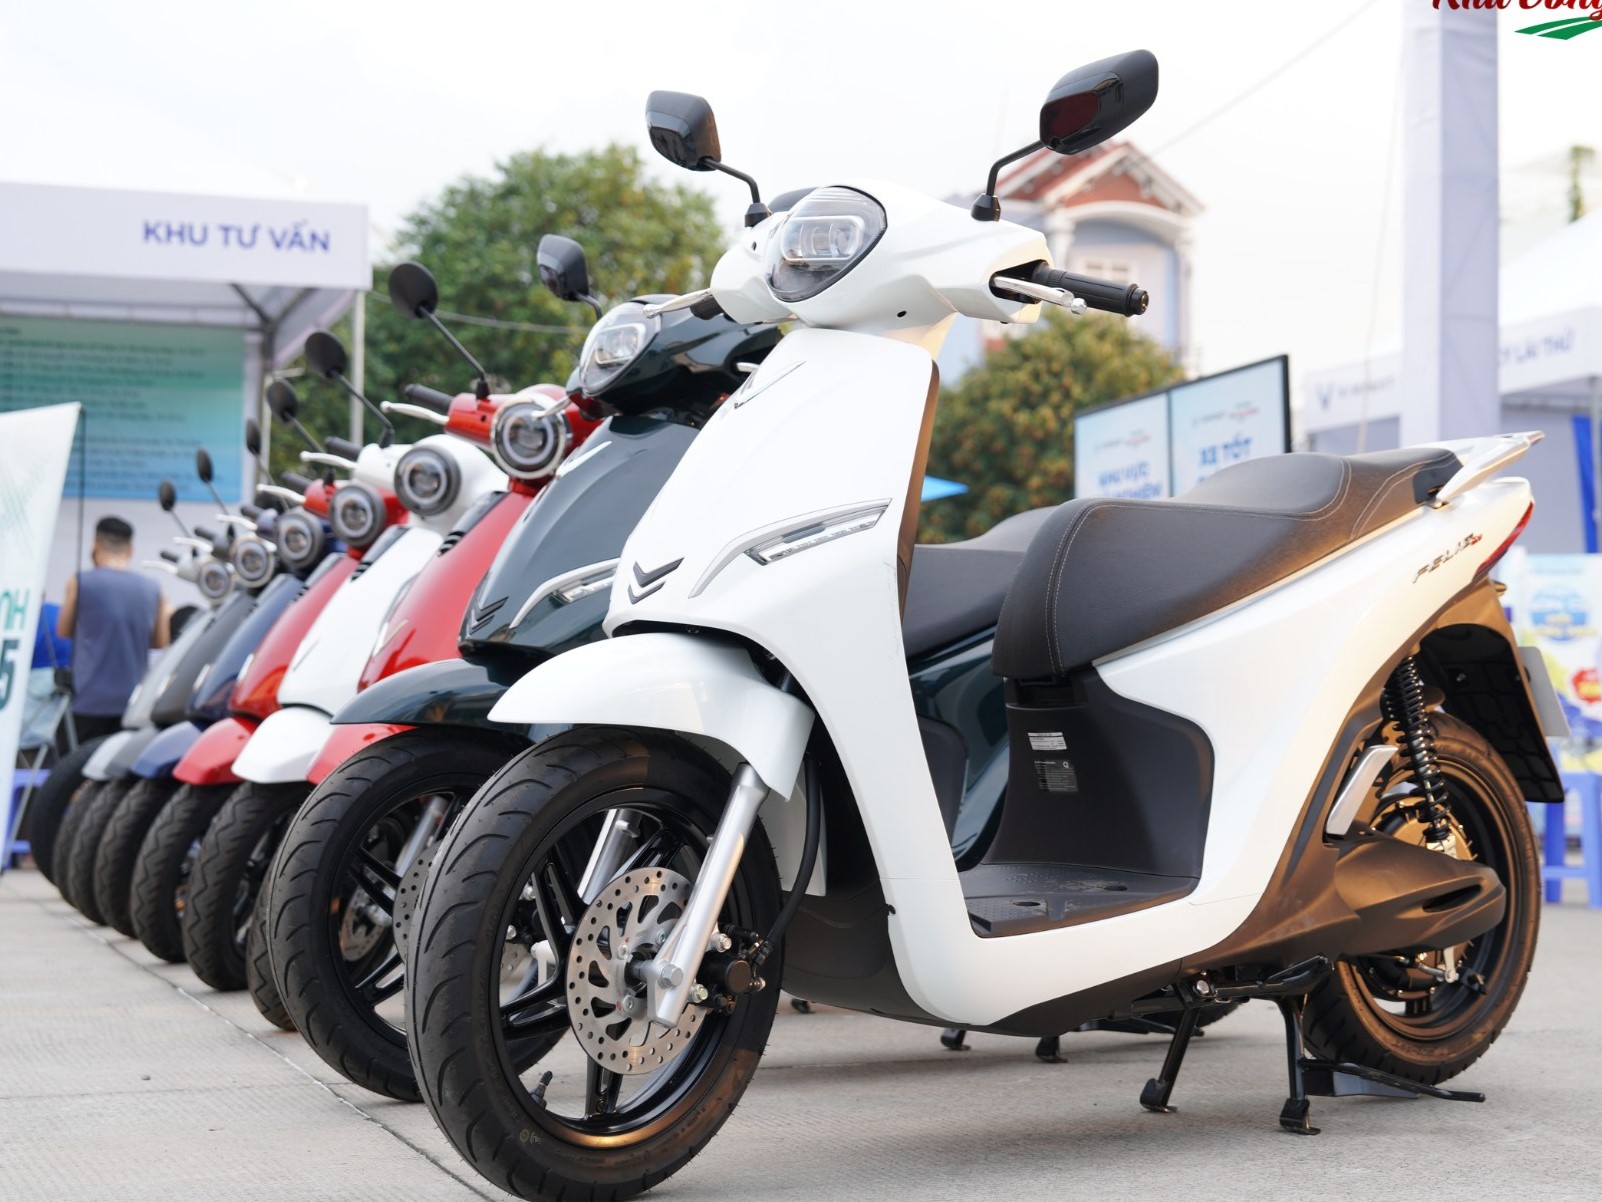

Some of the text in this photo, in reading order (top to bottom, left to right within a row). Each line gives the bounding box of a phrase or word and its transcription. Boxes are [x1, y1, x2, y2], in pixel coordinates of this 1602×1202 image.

[143, 218, 331, 251] KHU TƯ VẤN
